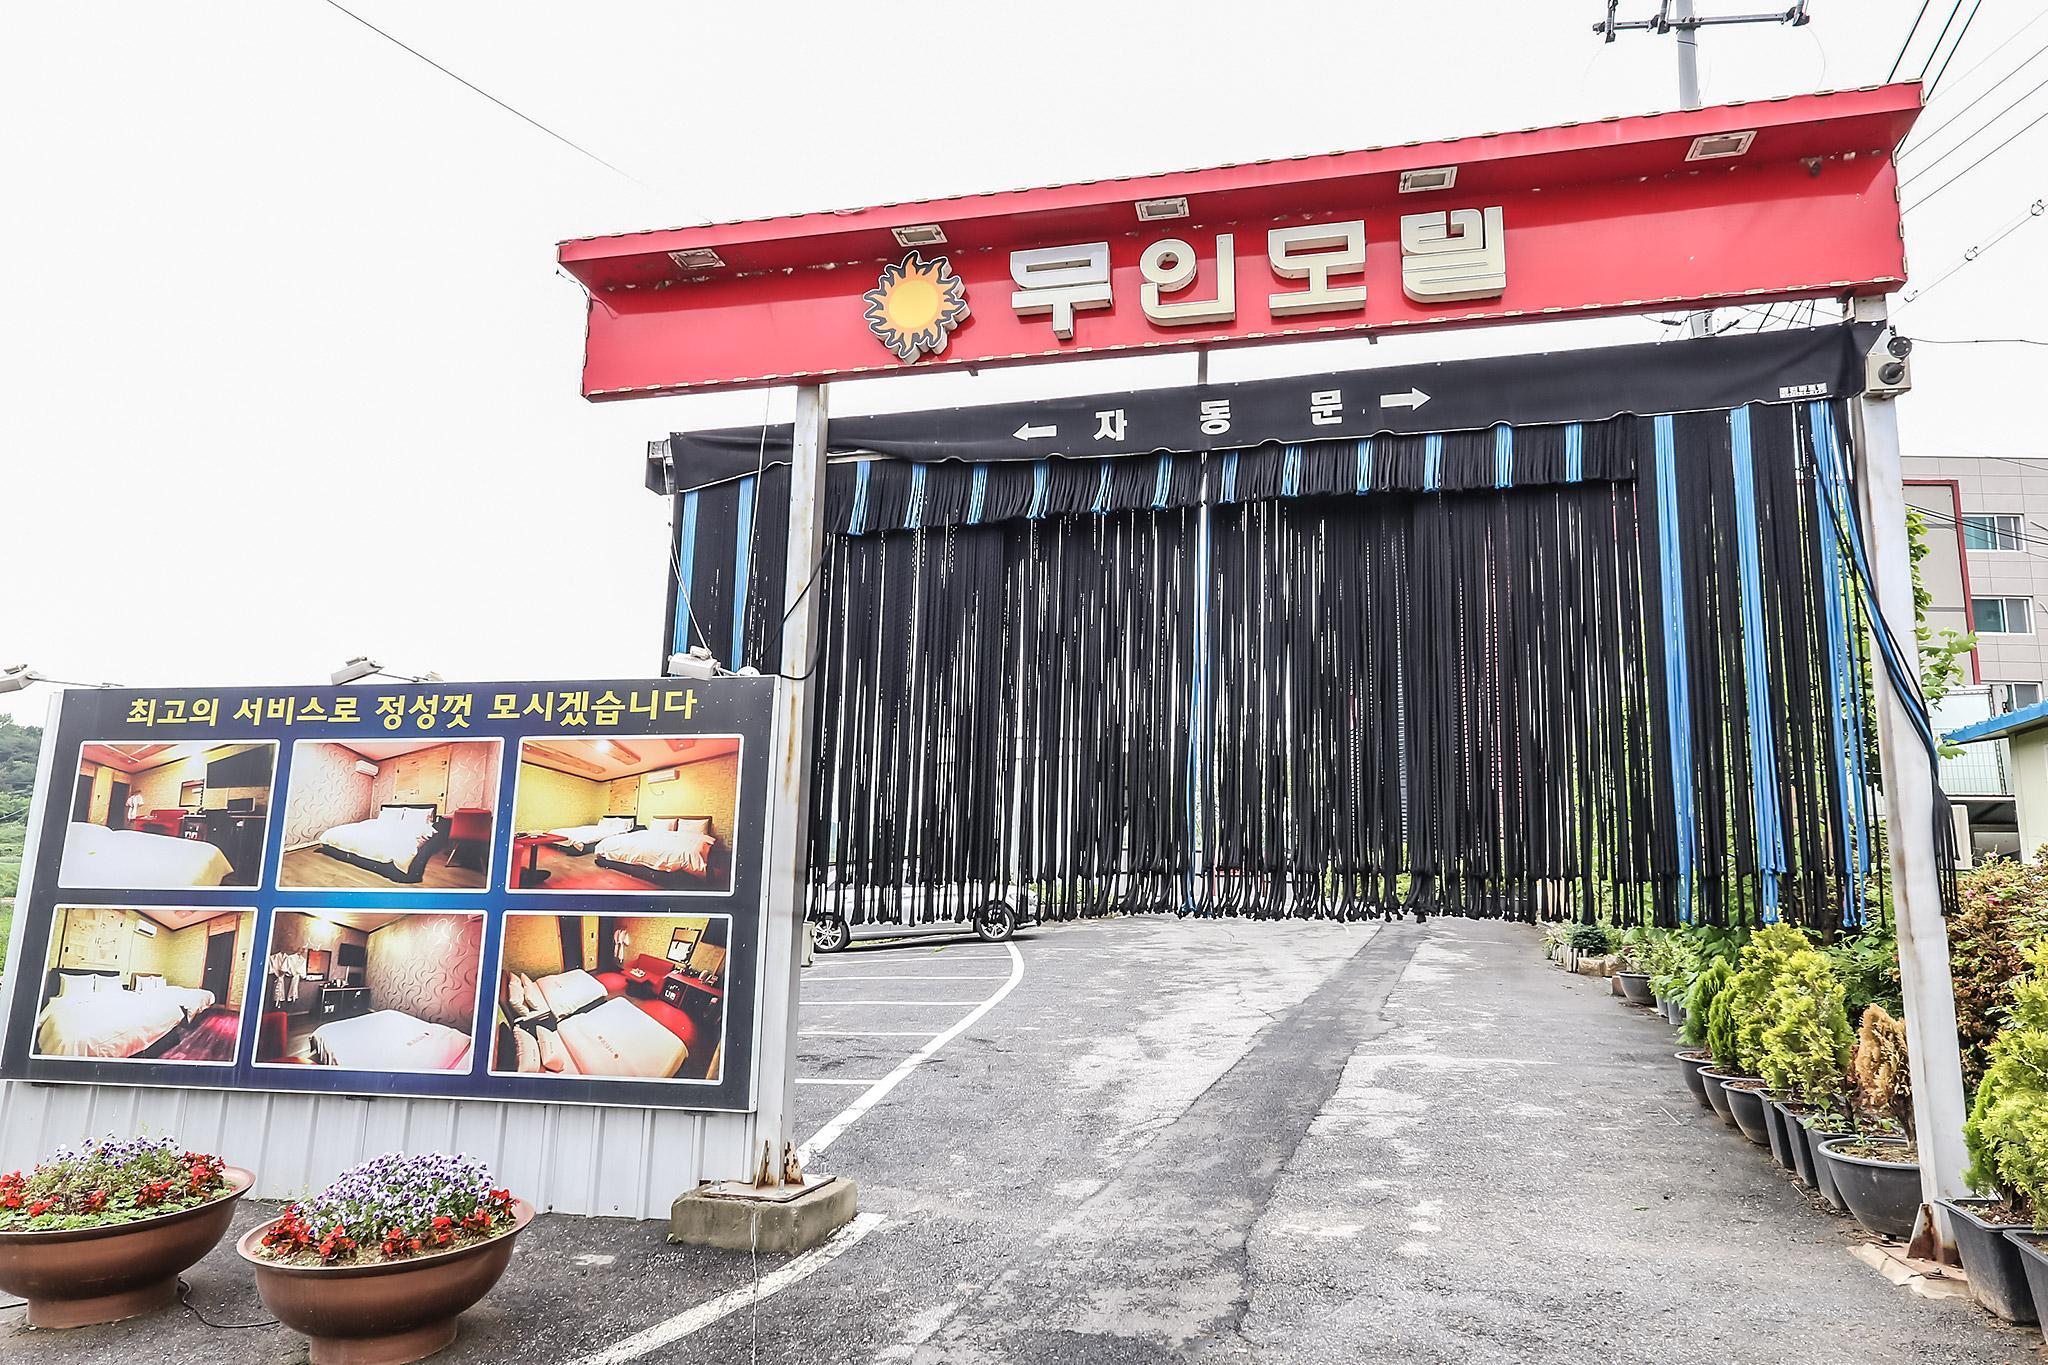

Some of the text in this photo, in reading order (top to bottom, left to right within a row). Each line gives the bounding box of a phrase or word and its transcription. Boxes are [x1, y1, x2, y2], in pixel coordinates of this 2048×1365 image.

[1010, 206, 1506, 340] 무인모텔
[126, 689, 698, 730] 최고의 서비스로 정성껏 모시겠습니다
